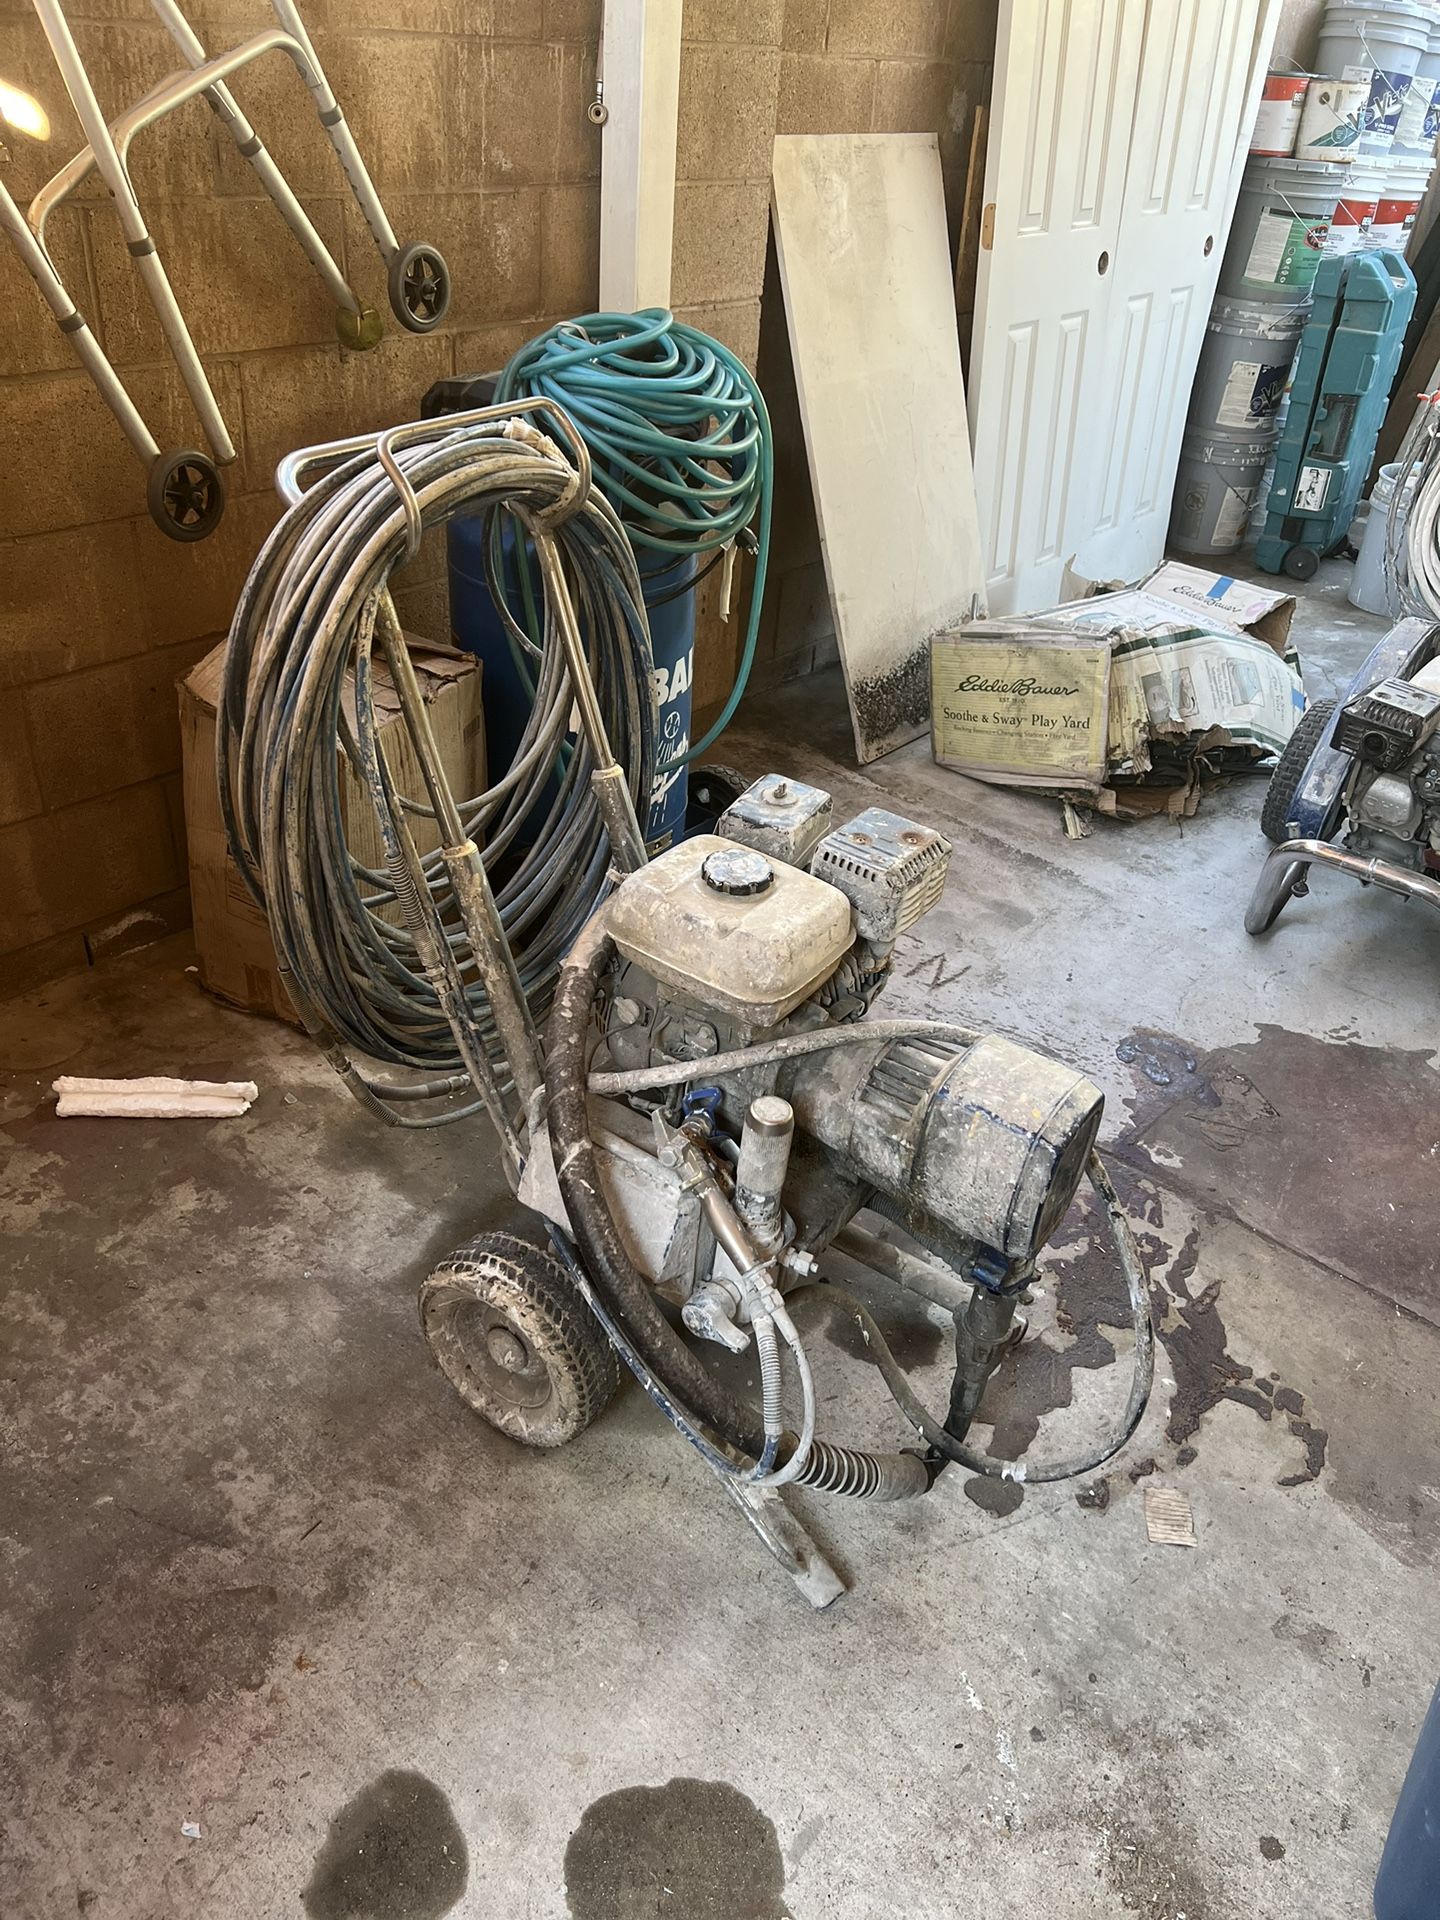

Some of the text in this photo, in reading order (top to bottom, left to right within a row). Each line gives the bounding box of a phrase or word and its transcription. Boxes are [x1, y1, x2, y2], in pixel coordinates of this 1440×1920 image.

[955, 675, 1079, 696] Eddie Bauer
[943, 707, 1090, 730] Soothe & Sway Play Yard
